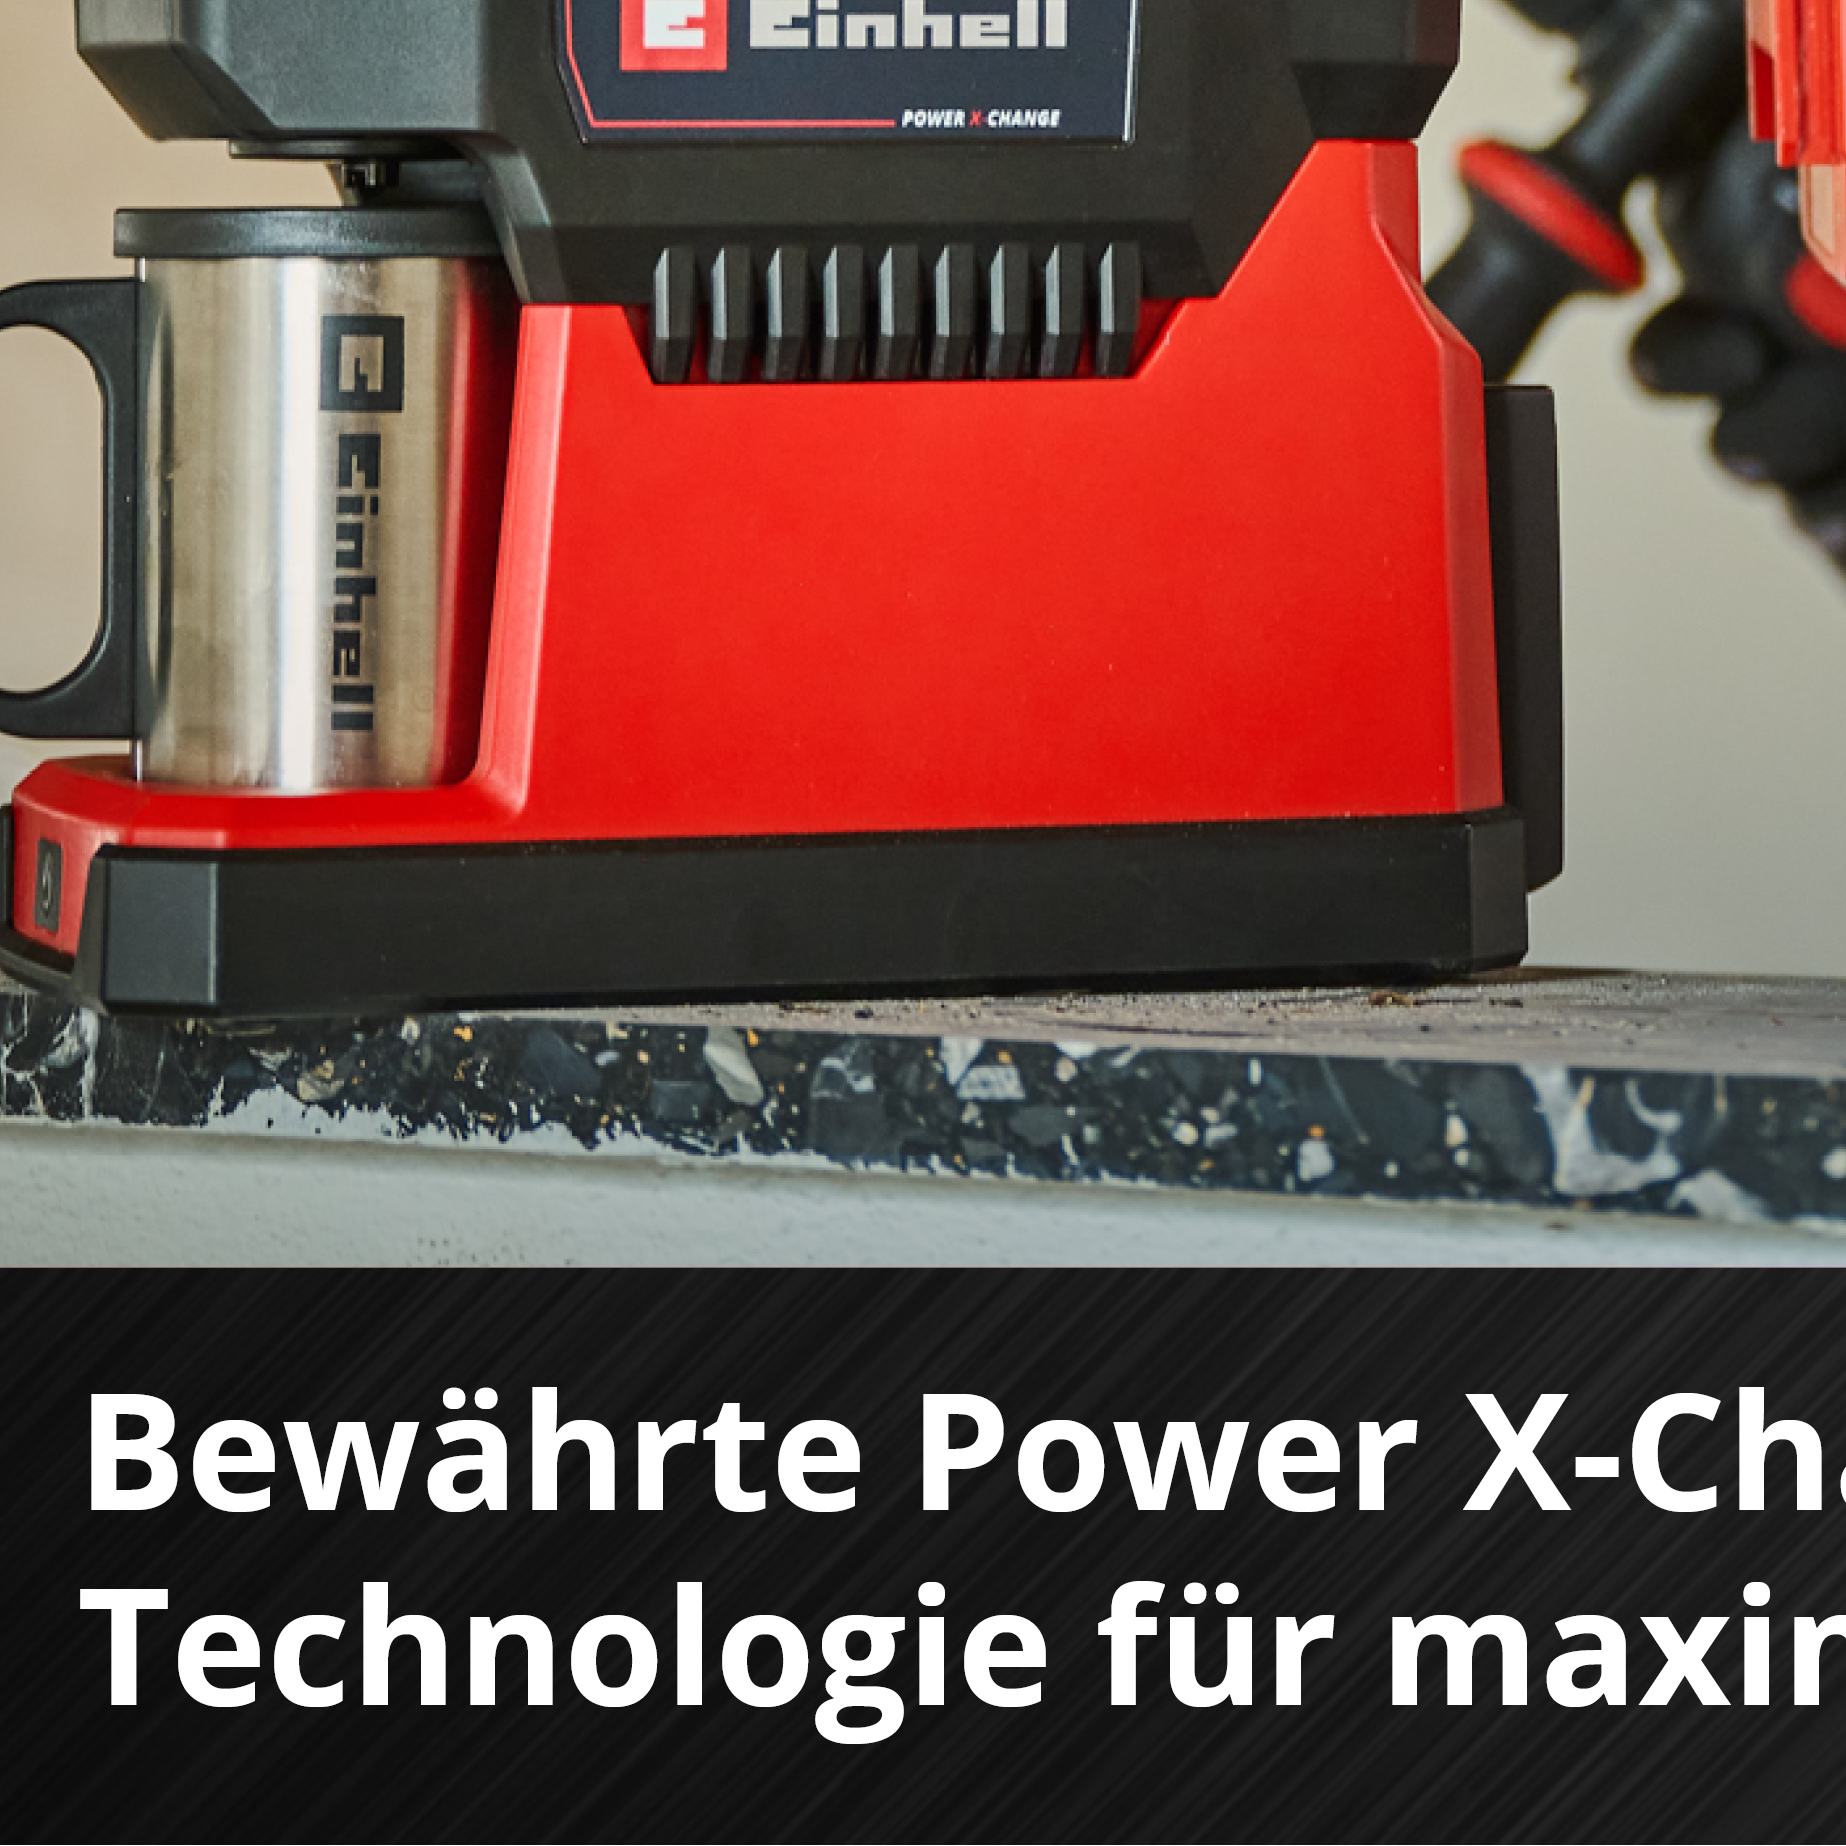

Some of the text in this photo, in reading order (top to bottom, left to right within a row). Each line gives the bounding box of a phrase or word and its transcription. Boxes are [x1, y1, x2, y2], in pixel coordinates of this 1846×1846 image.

[901, 109, 1062, 128] POWER X-CHANGE
[330, 433, 381, 731] Einhell
